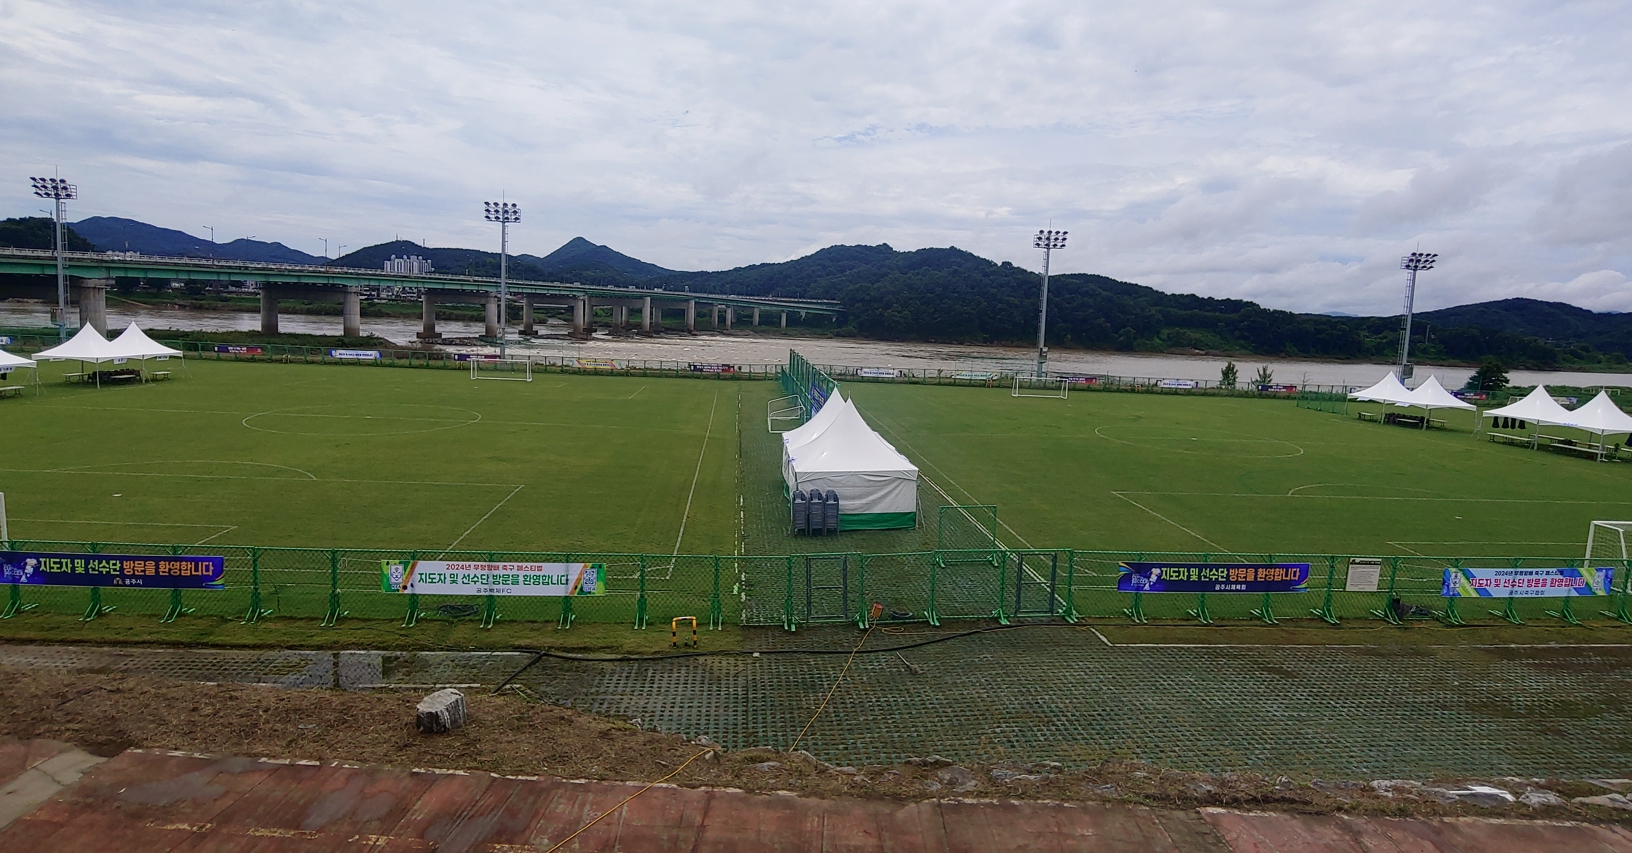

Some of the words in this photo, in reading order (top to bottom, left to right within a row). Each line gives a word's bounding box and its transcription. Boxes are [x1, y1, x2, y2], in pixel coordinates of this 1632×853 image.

[39, 557, 73, 573] 지도자
[74, 558, 86, 574] 및
[87, 559, 121, 575] 선수단
[122, 560, 156, 576] 방문을
[158, 560, 214, 577] 환영합니다
[445, 563, 471, 571] 2024년
[501, 564, 515, 572] 축구
[417, 572, 447, 584] 지도자
[449, 572, 459, 585] 및
[461, 573, 490, 585] 선수단
[492, 573, 520, 586] 방문을
[522, 573, 569, 586] 환영합니다
[1160, 567, 1189, 581] 지도자
[1189, 567, 1199, 581] 및
[1200, 567, 1228, 581] 선수단
[1229, 567, 1256, 582] 방문을
[1257, 567, 1300, 582] 환영합니다
[124, 578, 143, 586] 공주시
[1469, 577, 1492, 588] 지도자
[1493, 577, 1502, 588] 및
[1503, 577, 1525, 588] 선수단
[1526, 577, 1548, 588] 방문을
[1549, 577, 1586, 588] 환영합니다
